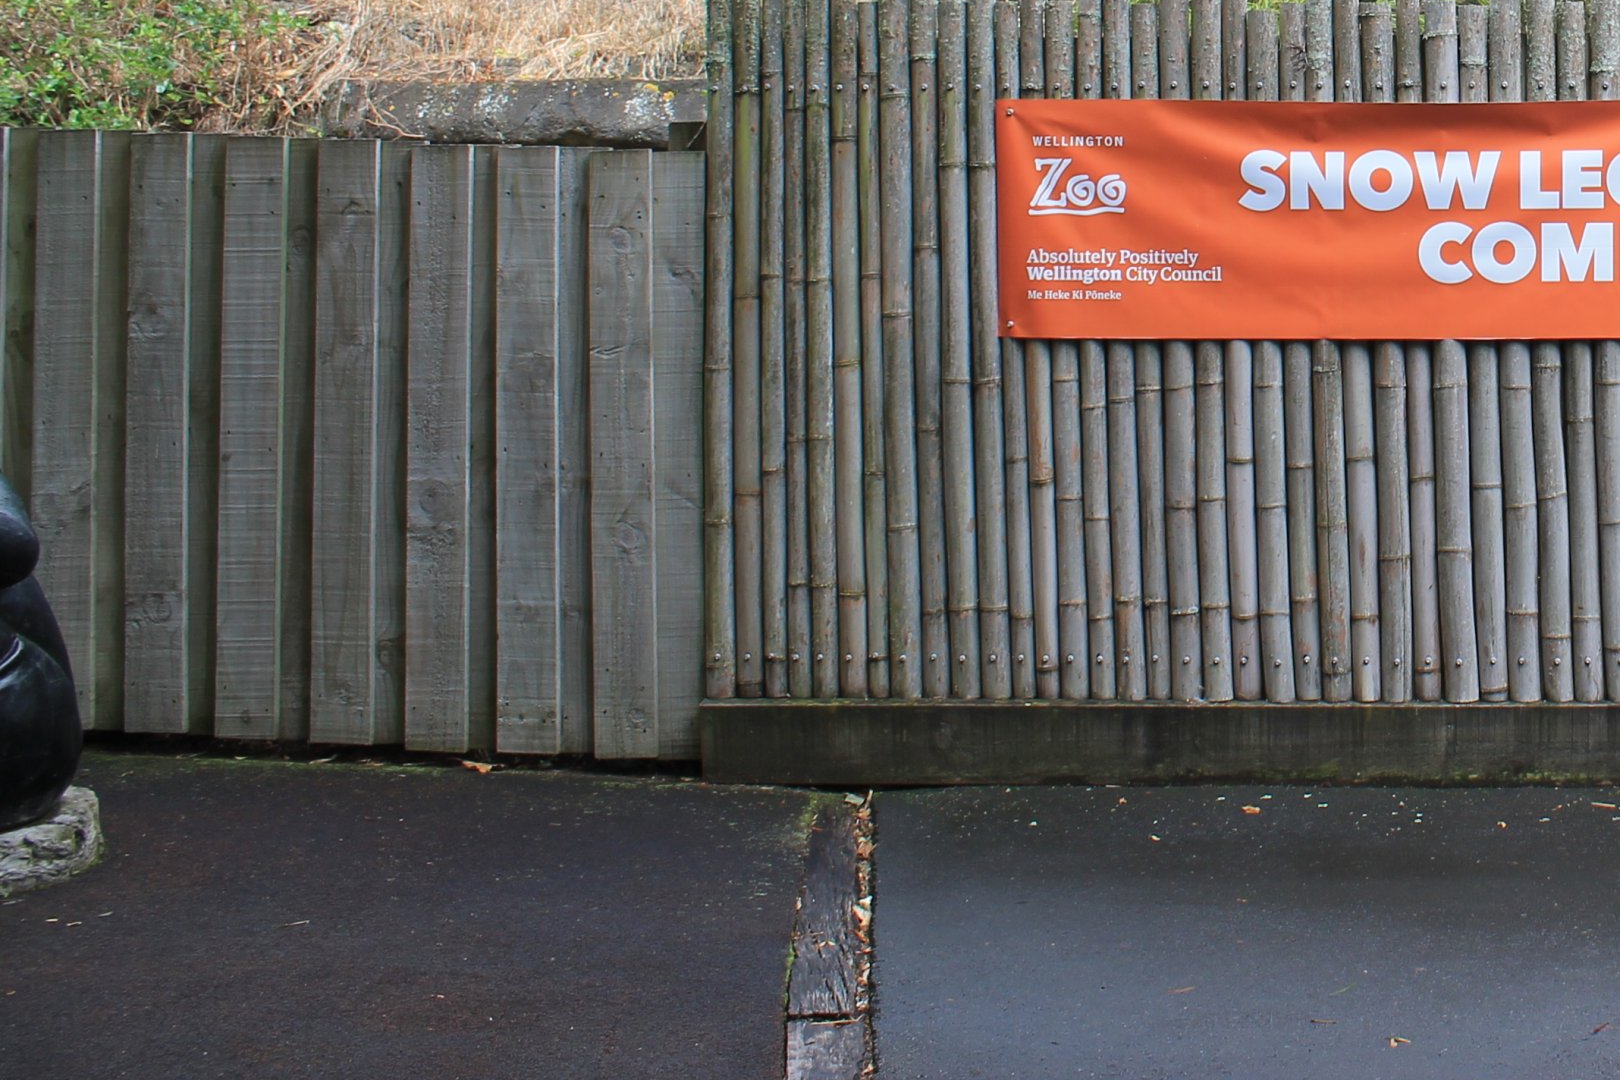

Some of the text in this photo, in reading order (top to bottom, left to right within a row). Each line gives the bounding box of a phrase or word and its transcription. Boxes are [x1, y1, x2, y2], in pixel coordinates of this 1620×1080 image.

[1032, 135, 1124, 147] WELLINGTON
[1029, 158, 1127, 207] Zoo
[1238, 148, 1502, 212] SNOW
[1027, 248, 1199, 268] Absolutely Positively
[1027, 265, 1223, 285] Wellington City Council
[1027, 289, 1043, 300] Me
[1044, 289, 1071, 300] Heke
[1072, 289, 1084, 300] Ki
